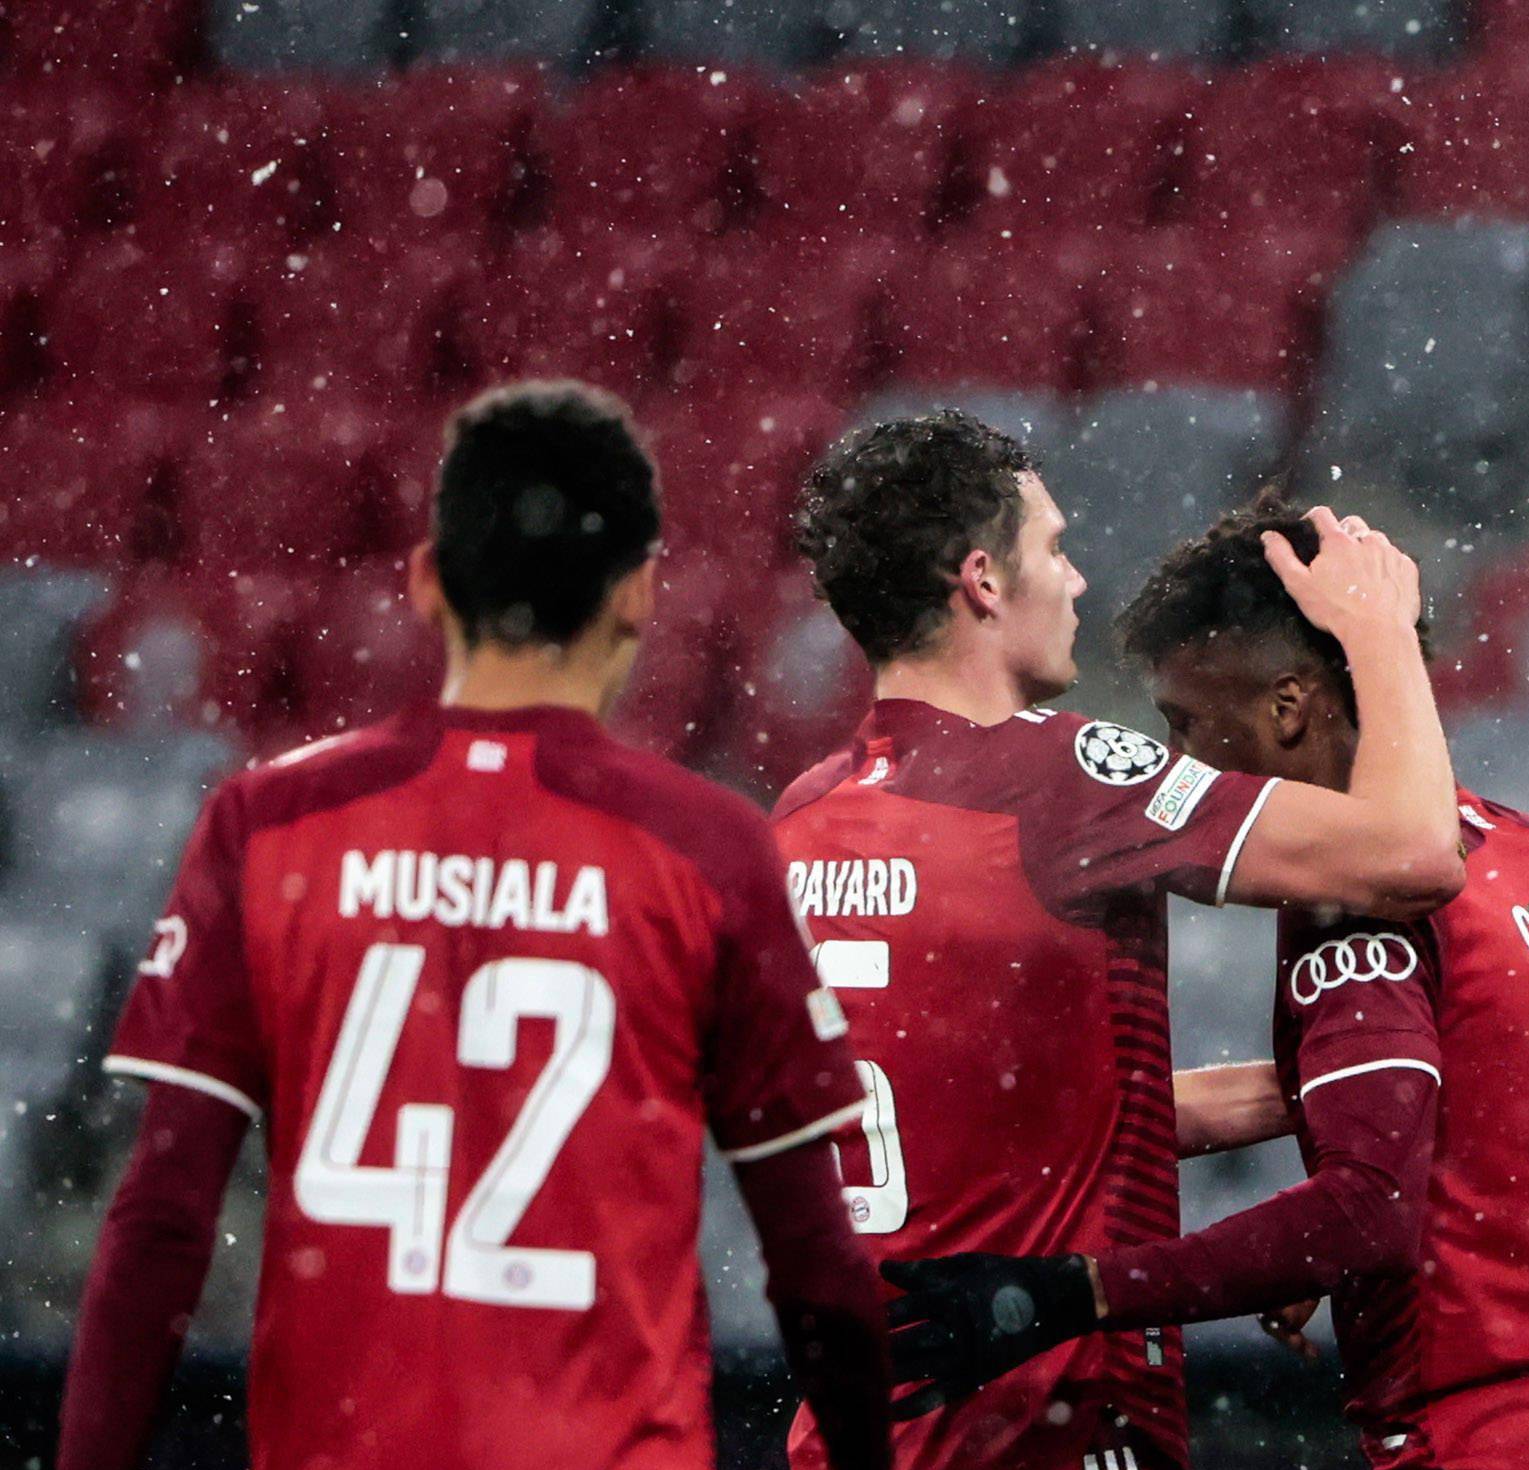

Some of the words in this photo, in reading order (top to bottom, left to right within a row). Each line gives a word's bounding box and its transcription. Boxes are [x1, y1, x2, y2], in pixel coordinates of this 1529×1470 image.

[340, 849, 608, 935] MUSIALA
[787, 858, 917, 917] PAVARD
[294, 943, 617, 1310] 42
